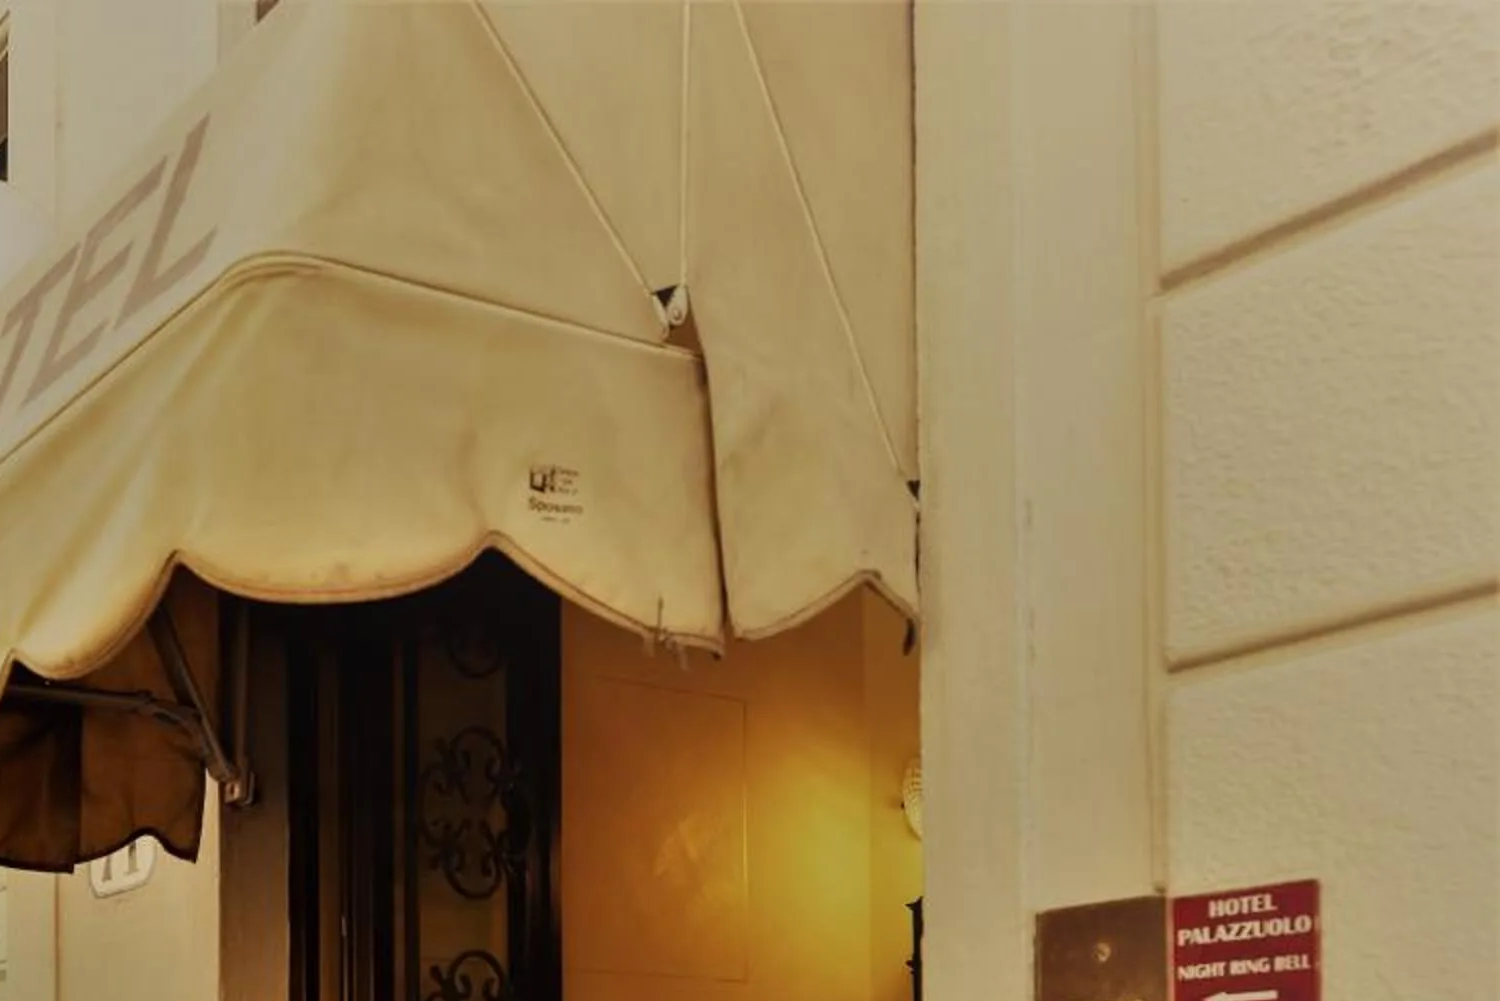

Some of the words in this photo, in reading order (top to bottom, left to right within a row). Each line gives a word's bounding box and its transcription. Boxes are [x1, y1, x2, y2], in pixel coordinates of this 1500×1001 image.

[1208, 894, 1277, 917] HOTEL
[1177, 915, 1311, 946] PALAZZUOLO
[1177, 961, 1226, 982] NIGHT
[1230, 957, 1271, 976] RING
[1274, 953, 1311, 973] BELL
